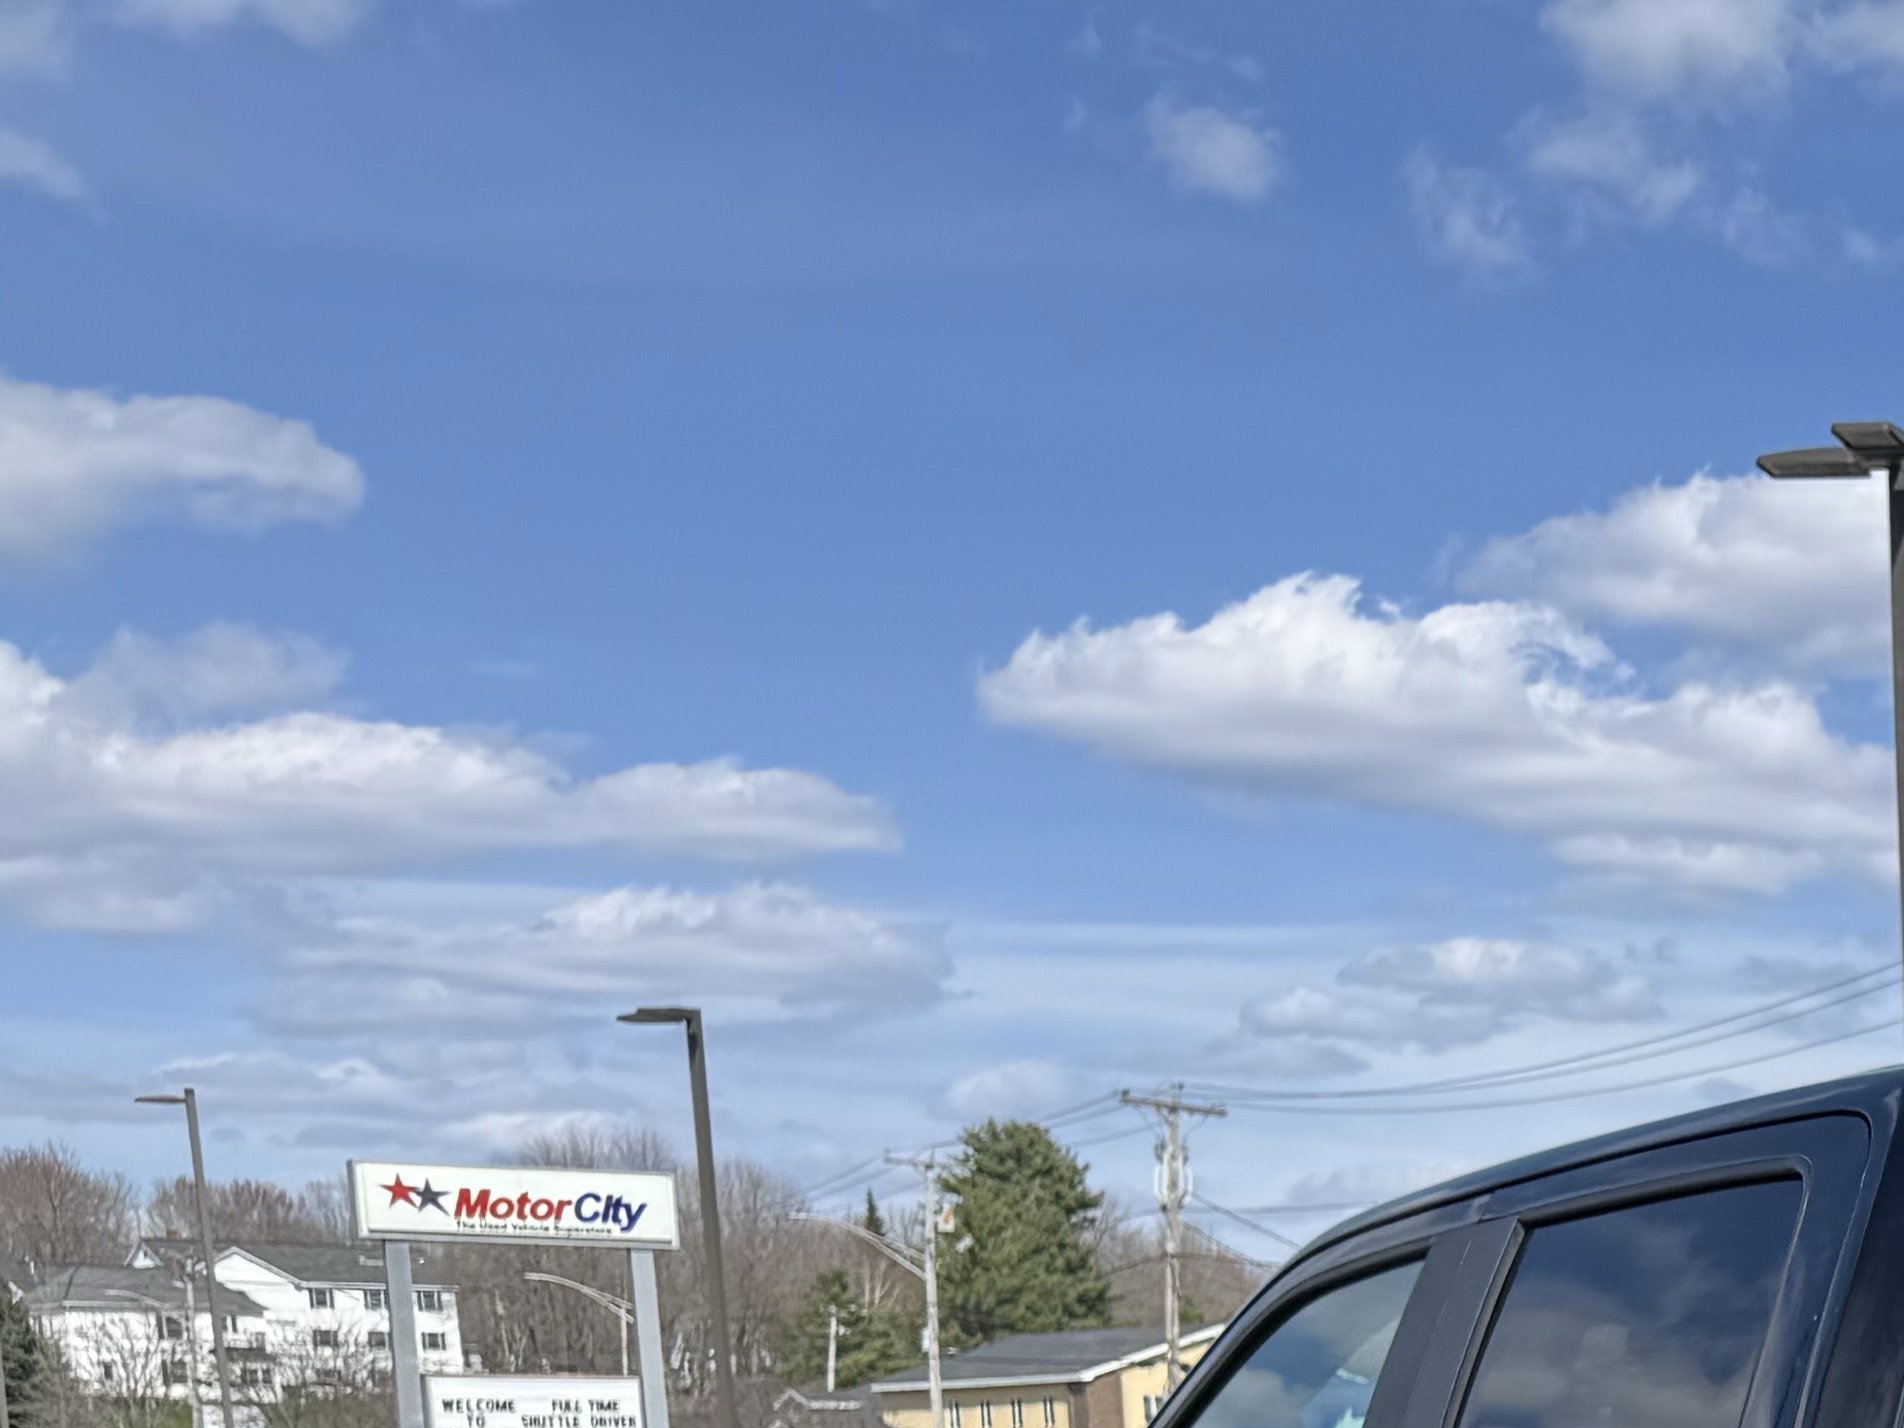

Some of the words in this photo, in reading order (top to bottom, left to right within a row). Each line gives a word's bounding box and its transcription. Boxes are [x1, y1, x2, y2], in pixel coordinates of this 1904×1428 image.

[454, 1187, 647, 1233] MotorCity
[442, 1398, 516, 1413] WELCOME
[551, 1399, 582, 1413] FULL
[588, 1399, 620, 1412] TIME
[466, 1414, 486, 1428] TO
[521, 1415, 580, 1428] SHUTTLE
[590, 1415, 637, 1428] DRIVER
